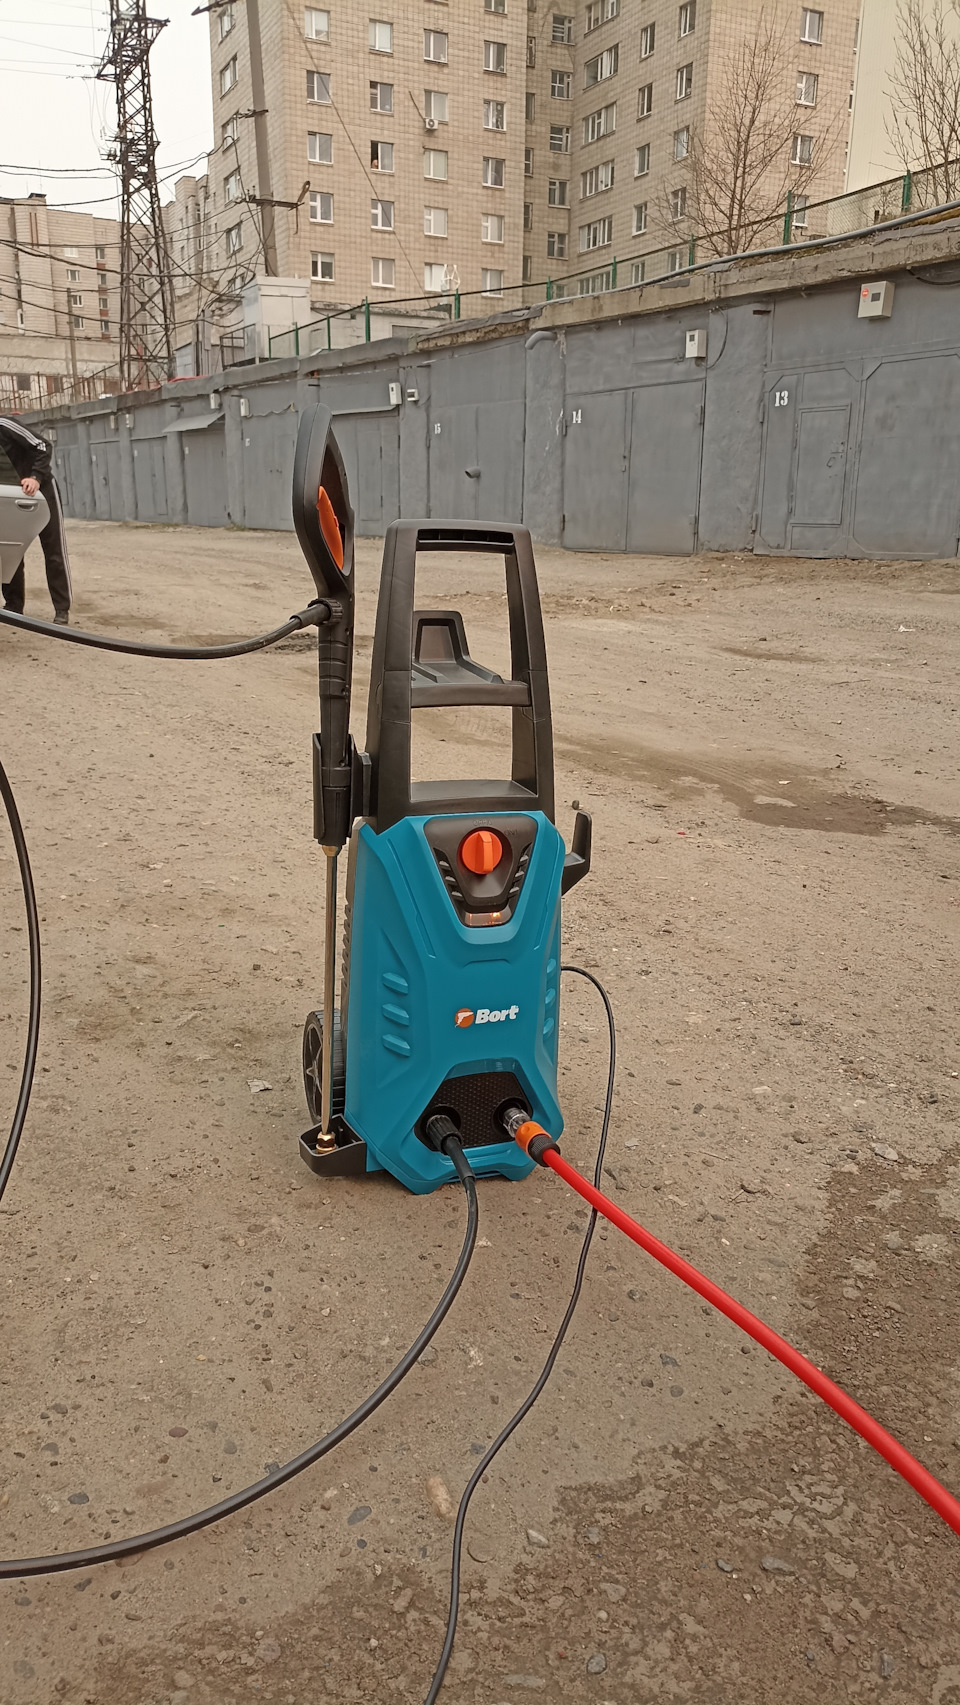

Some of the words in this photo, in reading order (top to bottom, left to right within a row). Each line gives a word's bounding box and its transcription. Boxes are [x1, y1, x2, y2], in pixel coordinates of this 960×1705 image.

[775, 390, 789, 407] 13
[572, 409, 582, 424] 14
[475, 1005, 520, 1025] Bort
